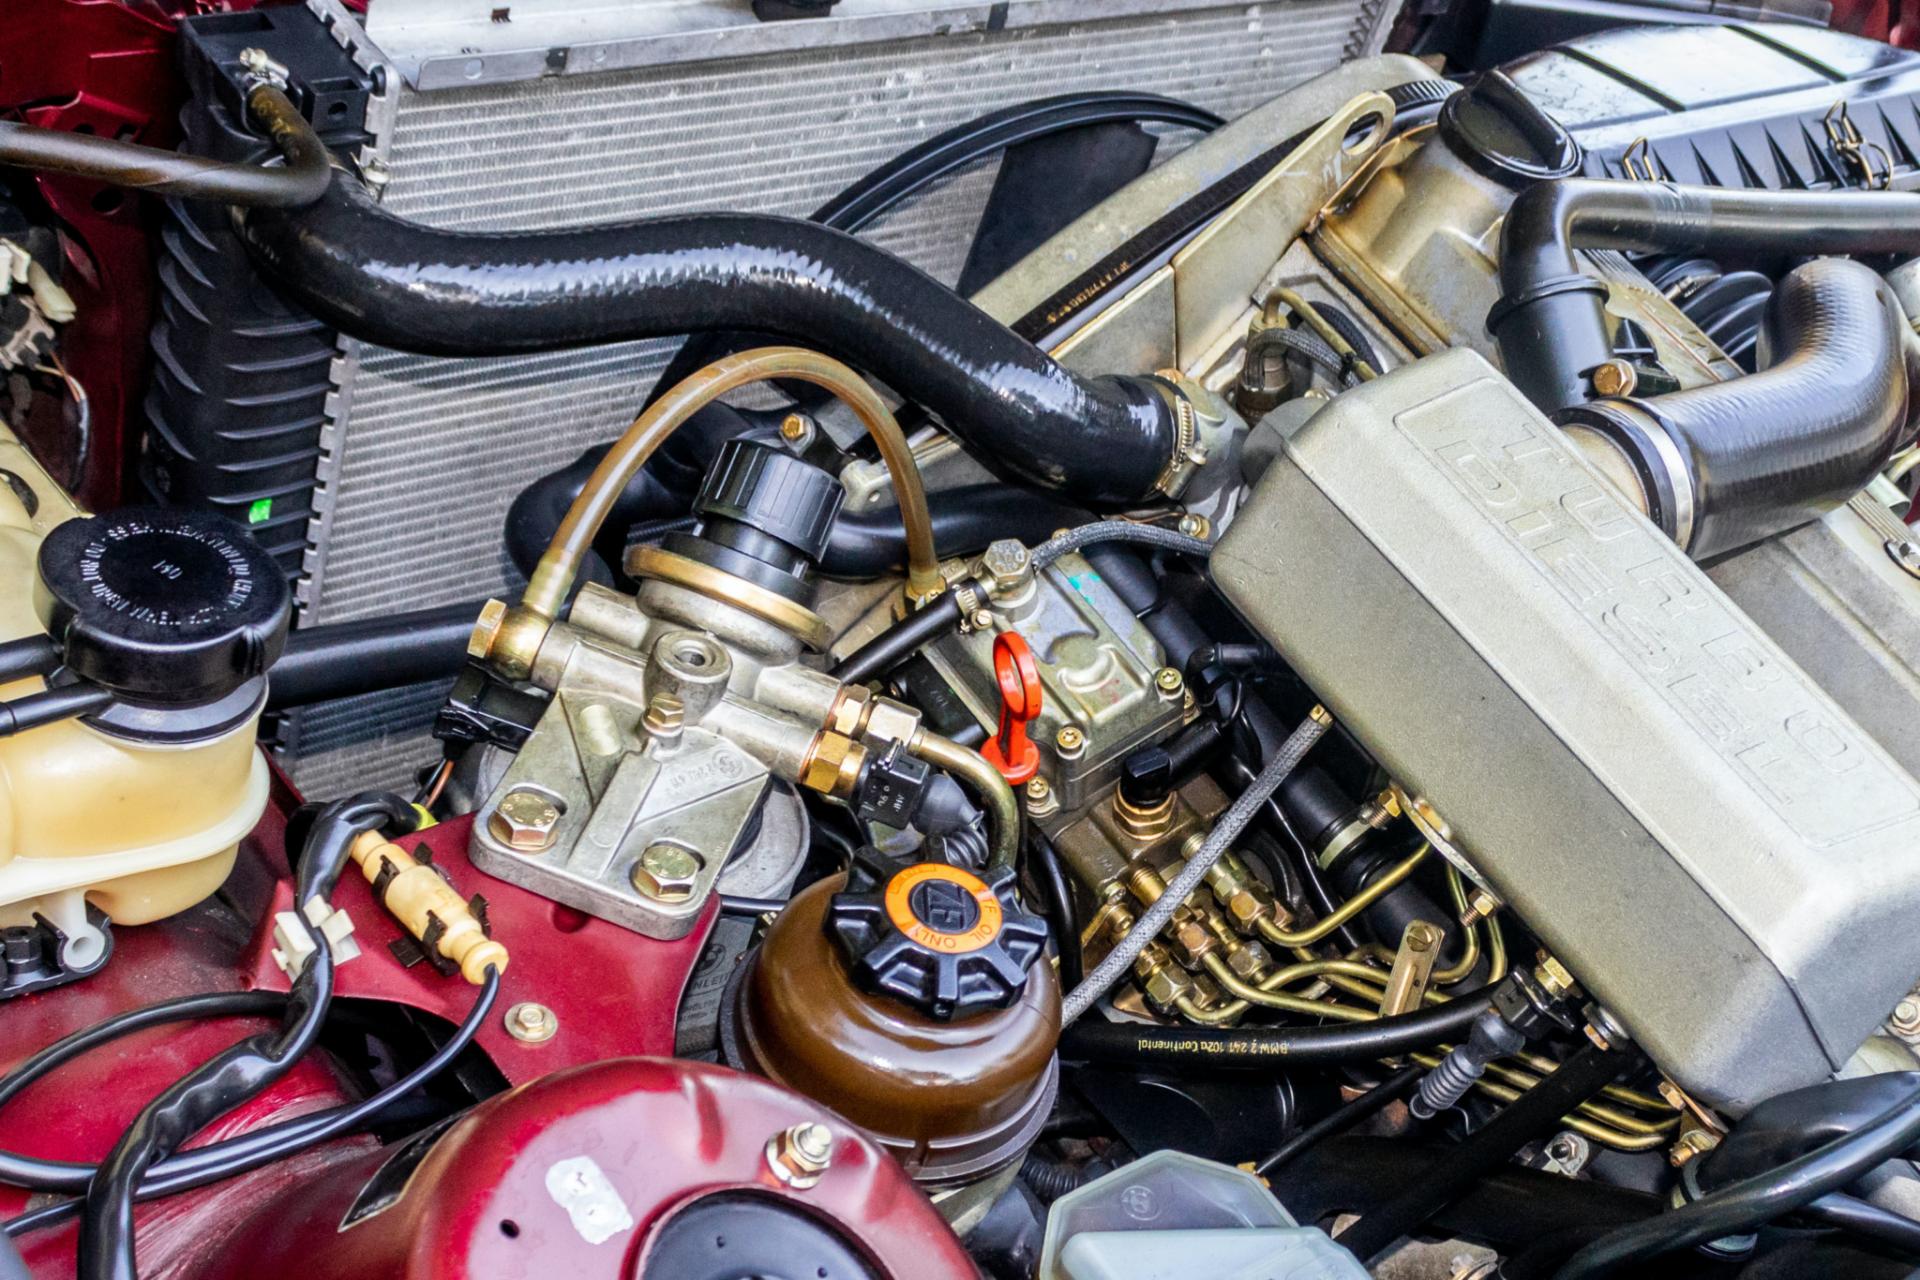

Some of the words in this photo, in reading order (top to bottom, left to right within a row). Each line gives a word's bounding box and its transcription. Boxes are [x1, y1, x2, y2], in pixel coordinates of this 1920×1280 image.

[1500, 422, 1867, 774] TURBO
[1433, 437, 1794, 806] DIESEL
[968, 924, 993, 942] OIL
[1138, 1039, 1199, 1053] Continental
[1229, 1041, 1247, 1054] 241
[1259, 1041, 1289, 1055] BMW
